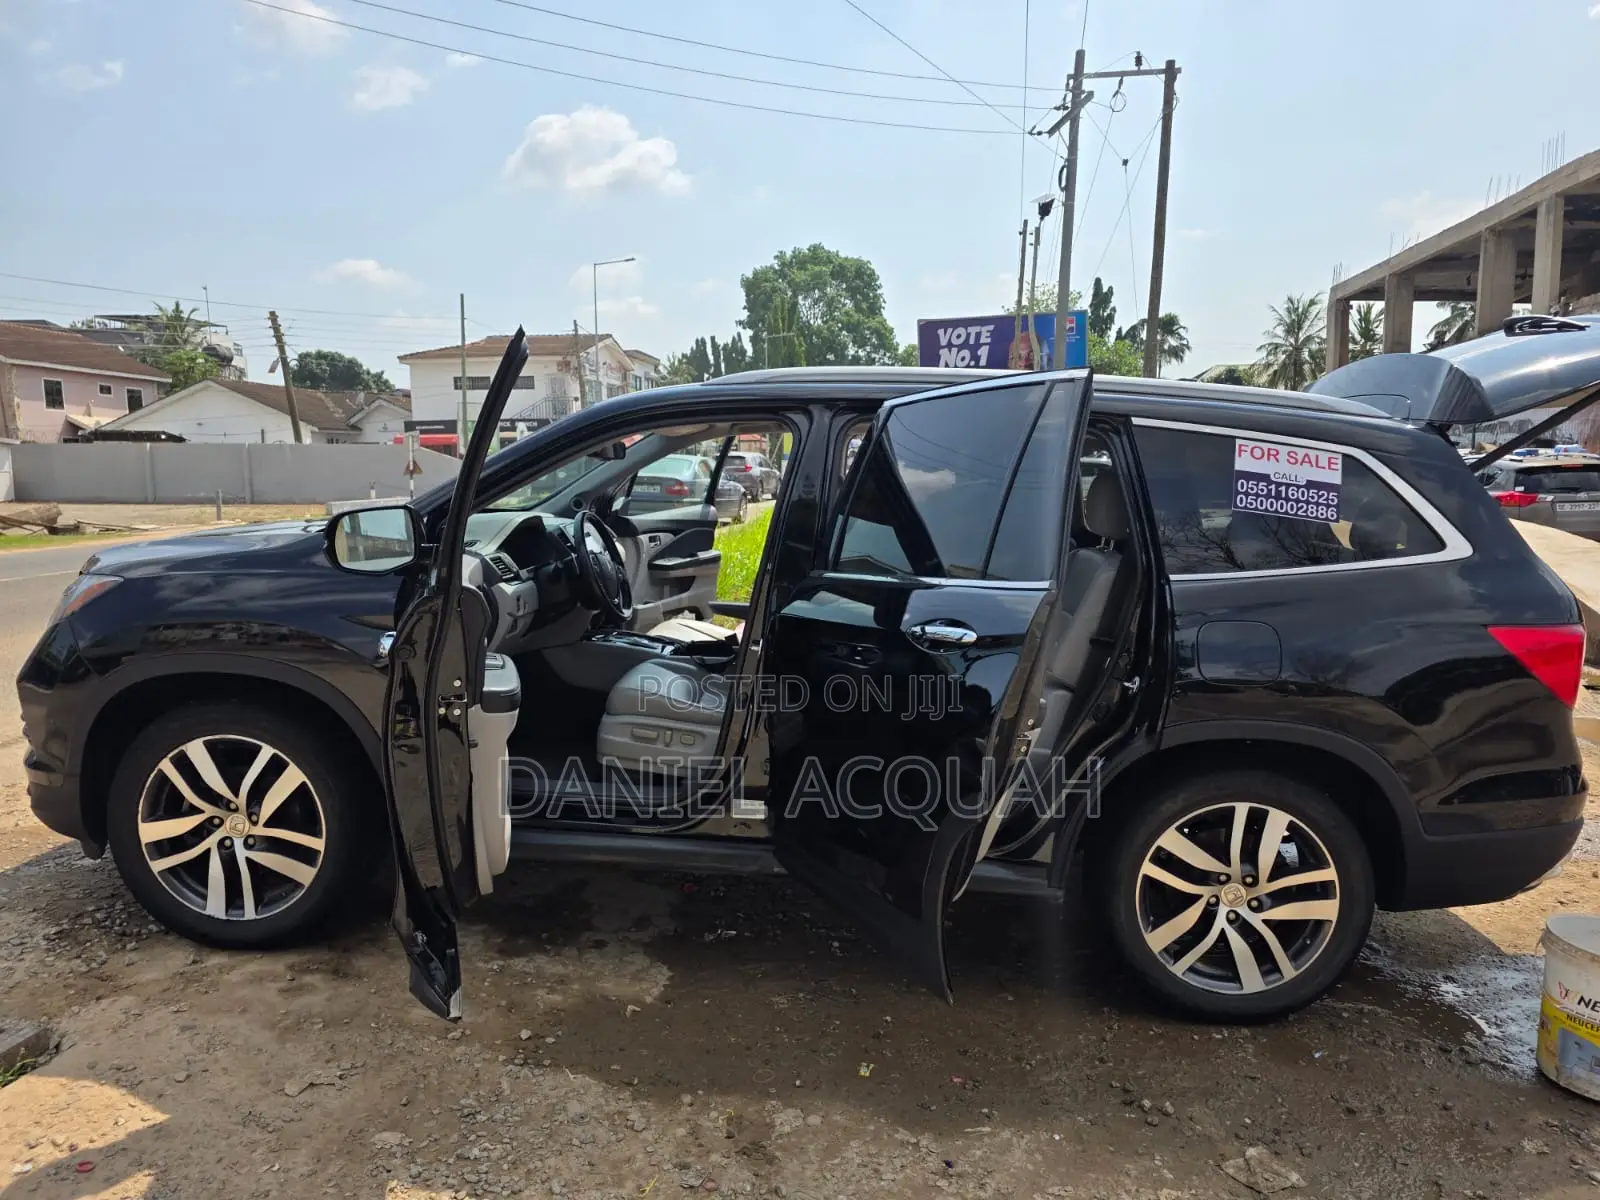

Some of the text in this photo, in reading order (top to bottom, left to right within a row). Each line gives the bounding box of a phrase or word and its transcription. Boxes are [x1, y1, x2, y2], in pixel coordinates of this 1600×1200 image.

[937, 325, 995, 346] VOTE
[1237, 443, 1340, 471] FOR SALE
[1237, 479, 1339, 505] 0551160525
[1236, 494, 1338, 520] 0500002886
